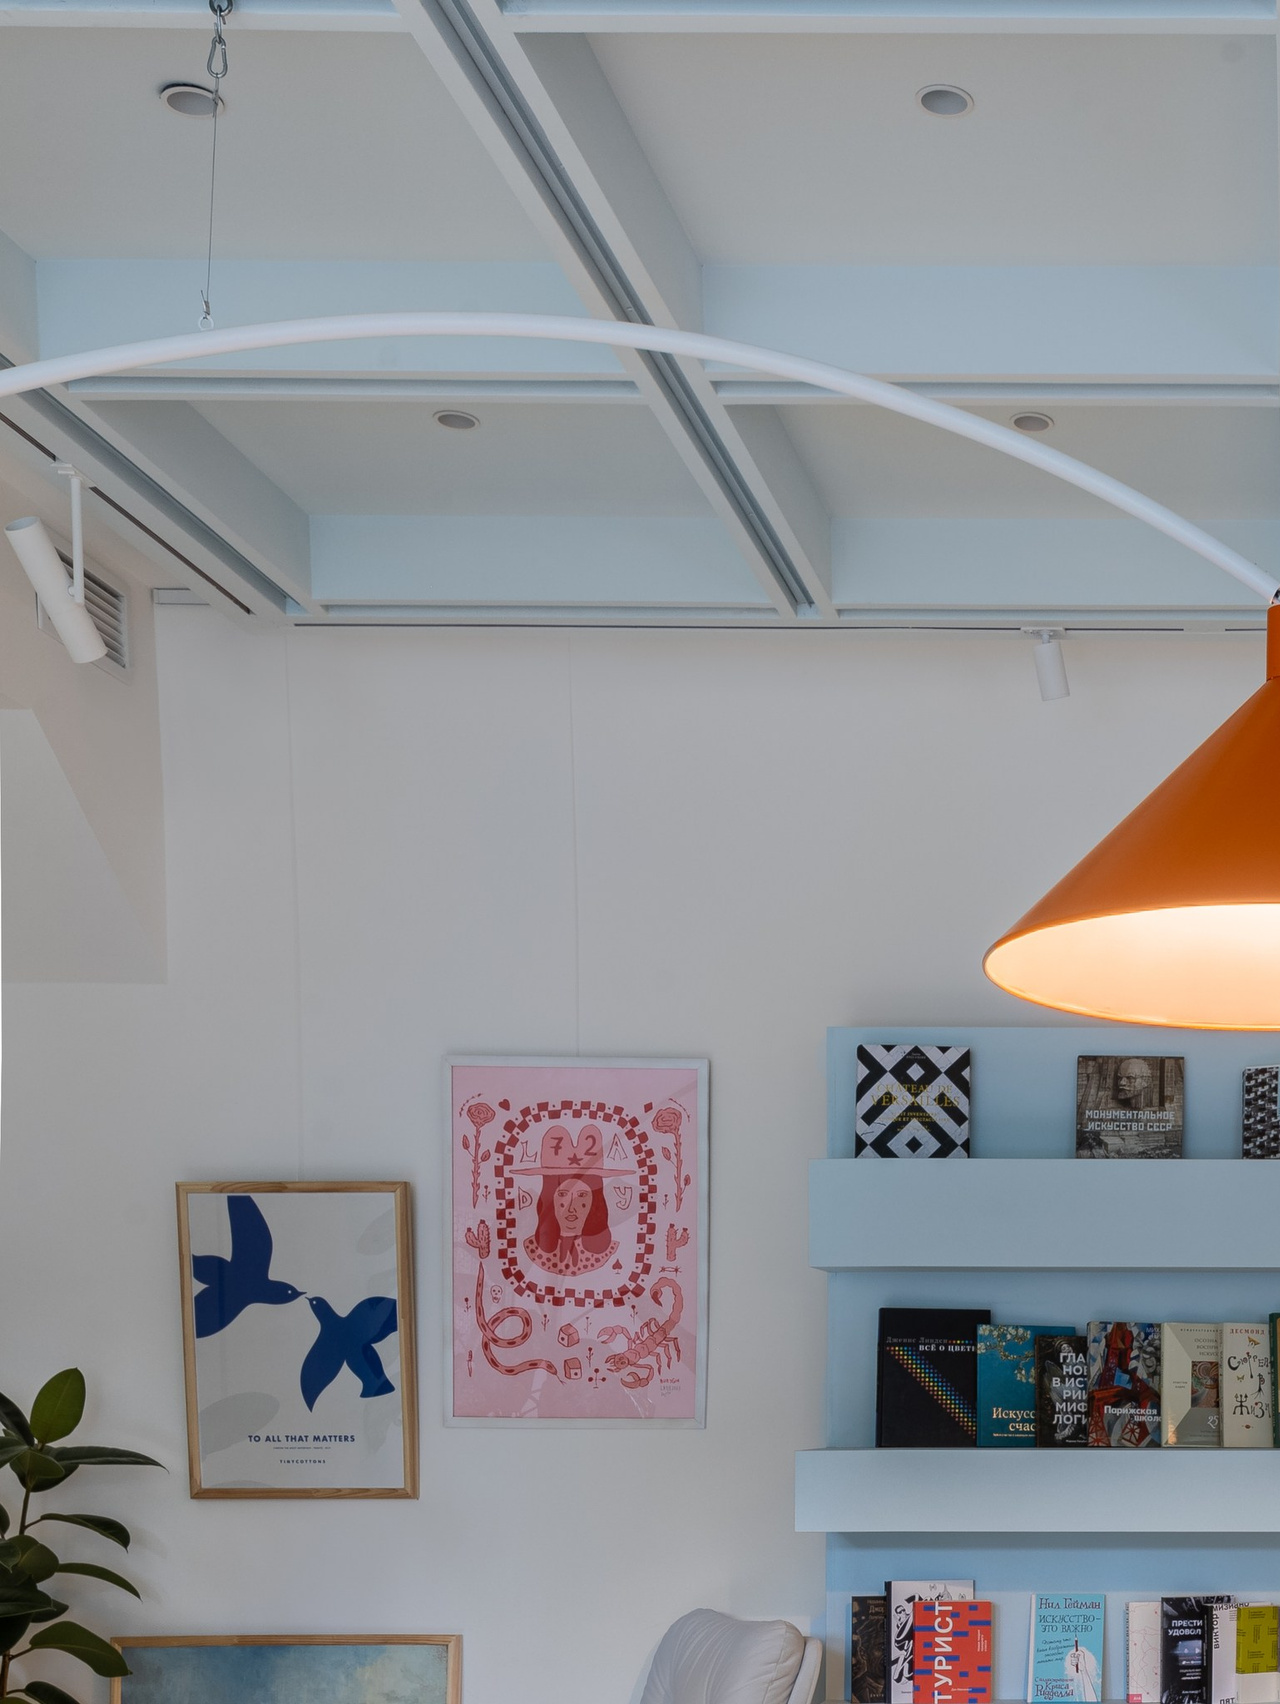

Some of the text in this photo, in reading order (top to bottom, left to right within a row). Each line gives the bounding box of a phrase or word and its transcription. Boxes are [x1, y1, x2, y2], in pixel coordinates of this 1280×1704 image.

[871, 1094, 960, 1107] VERSAILLES
[1085, 1110, 1176, 1120] МОНУМЕНТАЛЬНОЕ
[1085, 1122, 1172, 1132] ИСКУССТВО СССР
[550, 1136, 564, 1156] 7
[584, 1134, 598, 1156] 2
[919, 1343, 936, 1352] ВСЁ
[1052, 1378, 1060, 1388] В
[1104, 1405, 1158, 1416] Парижская
[1039, 1598, 1101, 1610] Нил Гейман
[1041, 1625, 1093, 1633] ЭТО ВАЖНО
[934, 1602, 953, 1704] ТУРИСТ
